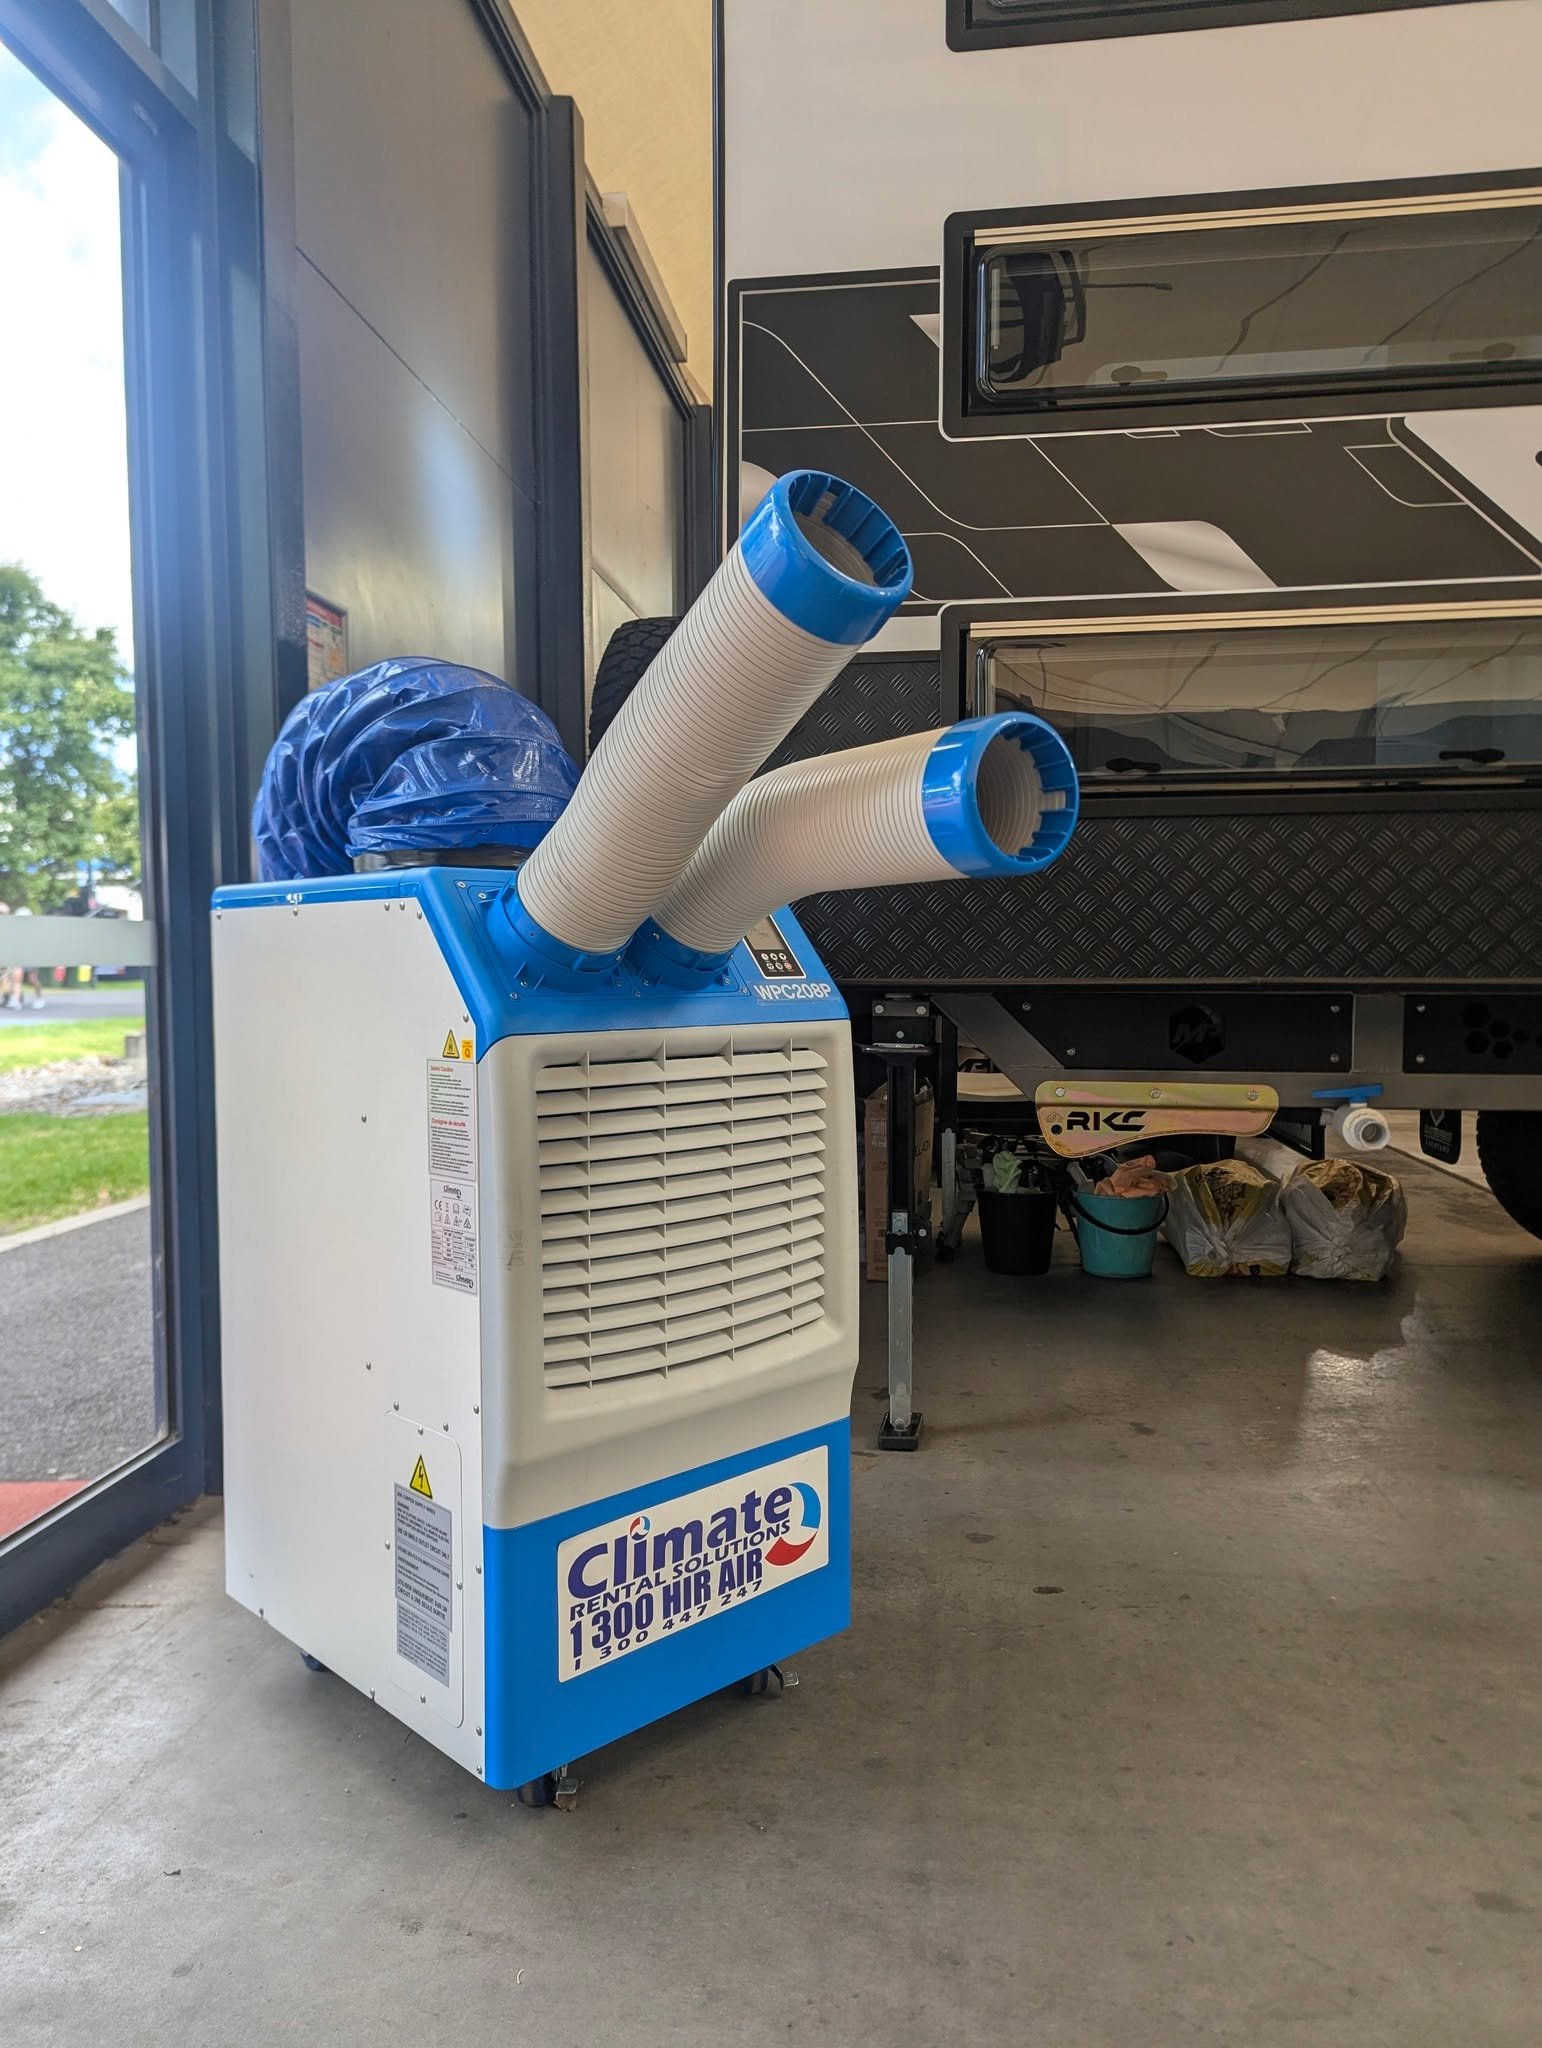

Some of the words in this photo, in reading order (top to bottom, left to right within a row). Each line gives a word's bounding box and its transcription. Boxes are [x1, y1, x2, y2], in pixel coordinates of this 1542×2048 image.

[753, 983, 832, 1000] WPC208P
[567, 1486, 793, 1600] Climate
[569, 1574, 667, 1621] RENTAL
[672, 1519, 791, 1580] SOLUTIONS
[570, 1620, 583, 1659] 1
[591, 1592, 655, 1649] 300
[662, 1568, 712, 1620] HIR
[717, 1547, 763, 1597] AIR
[599, 1630, 649, 1660] 300
[720, 1580, 763, 1607] 247
